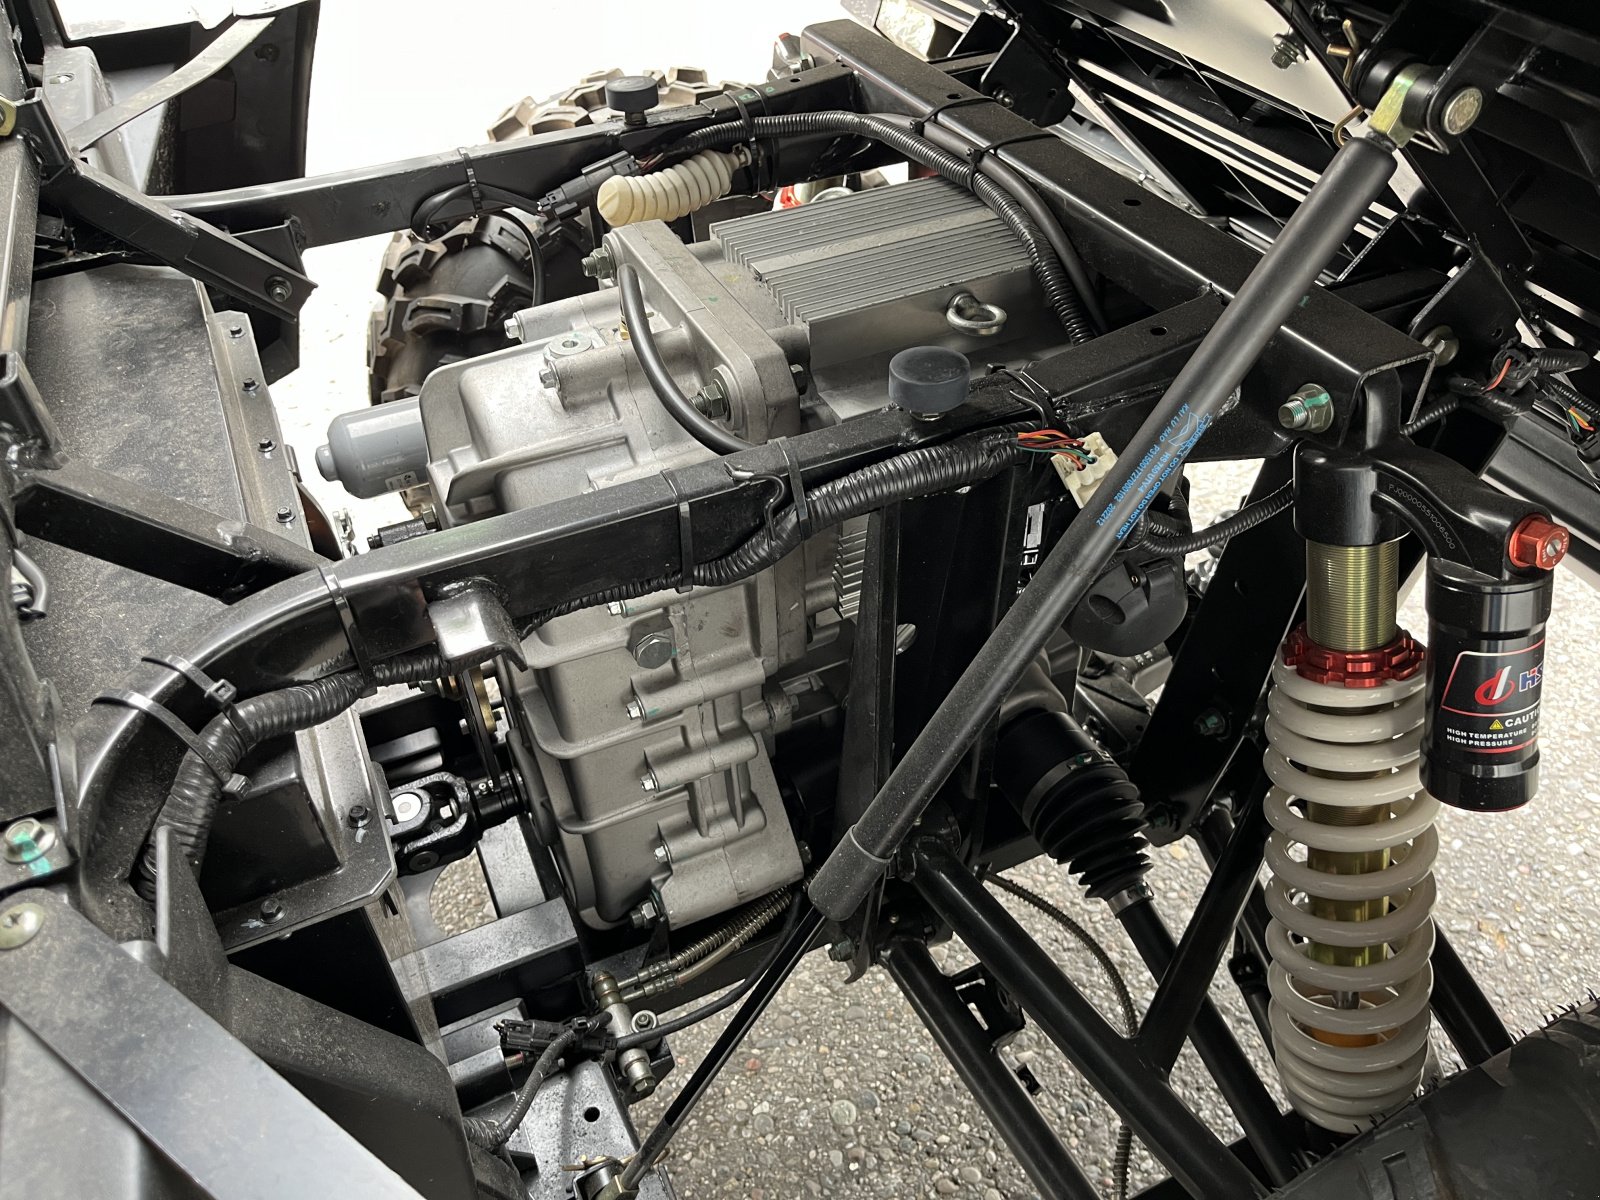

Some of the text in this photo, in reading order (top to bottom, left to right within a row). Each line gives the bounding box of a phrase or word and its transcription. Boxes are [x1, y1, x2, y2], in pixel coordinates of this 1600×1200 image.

[1158, 467, 1171, 481] NOT
[1145, 480, 1161, 500] OPEN
[1095, 502, 1115, 526] 202212
[1127, 508, 1140, 523] NOT
[1115, 521, 1130, 539] HEAT
[1447, 728, 1467, 737] HIGH
[1469, 728, 1527, 739] TEMPERATURE
[1447, 735, 1467, 744] HIGH
